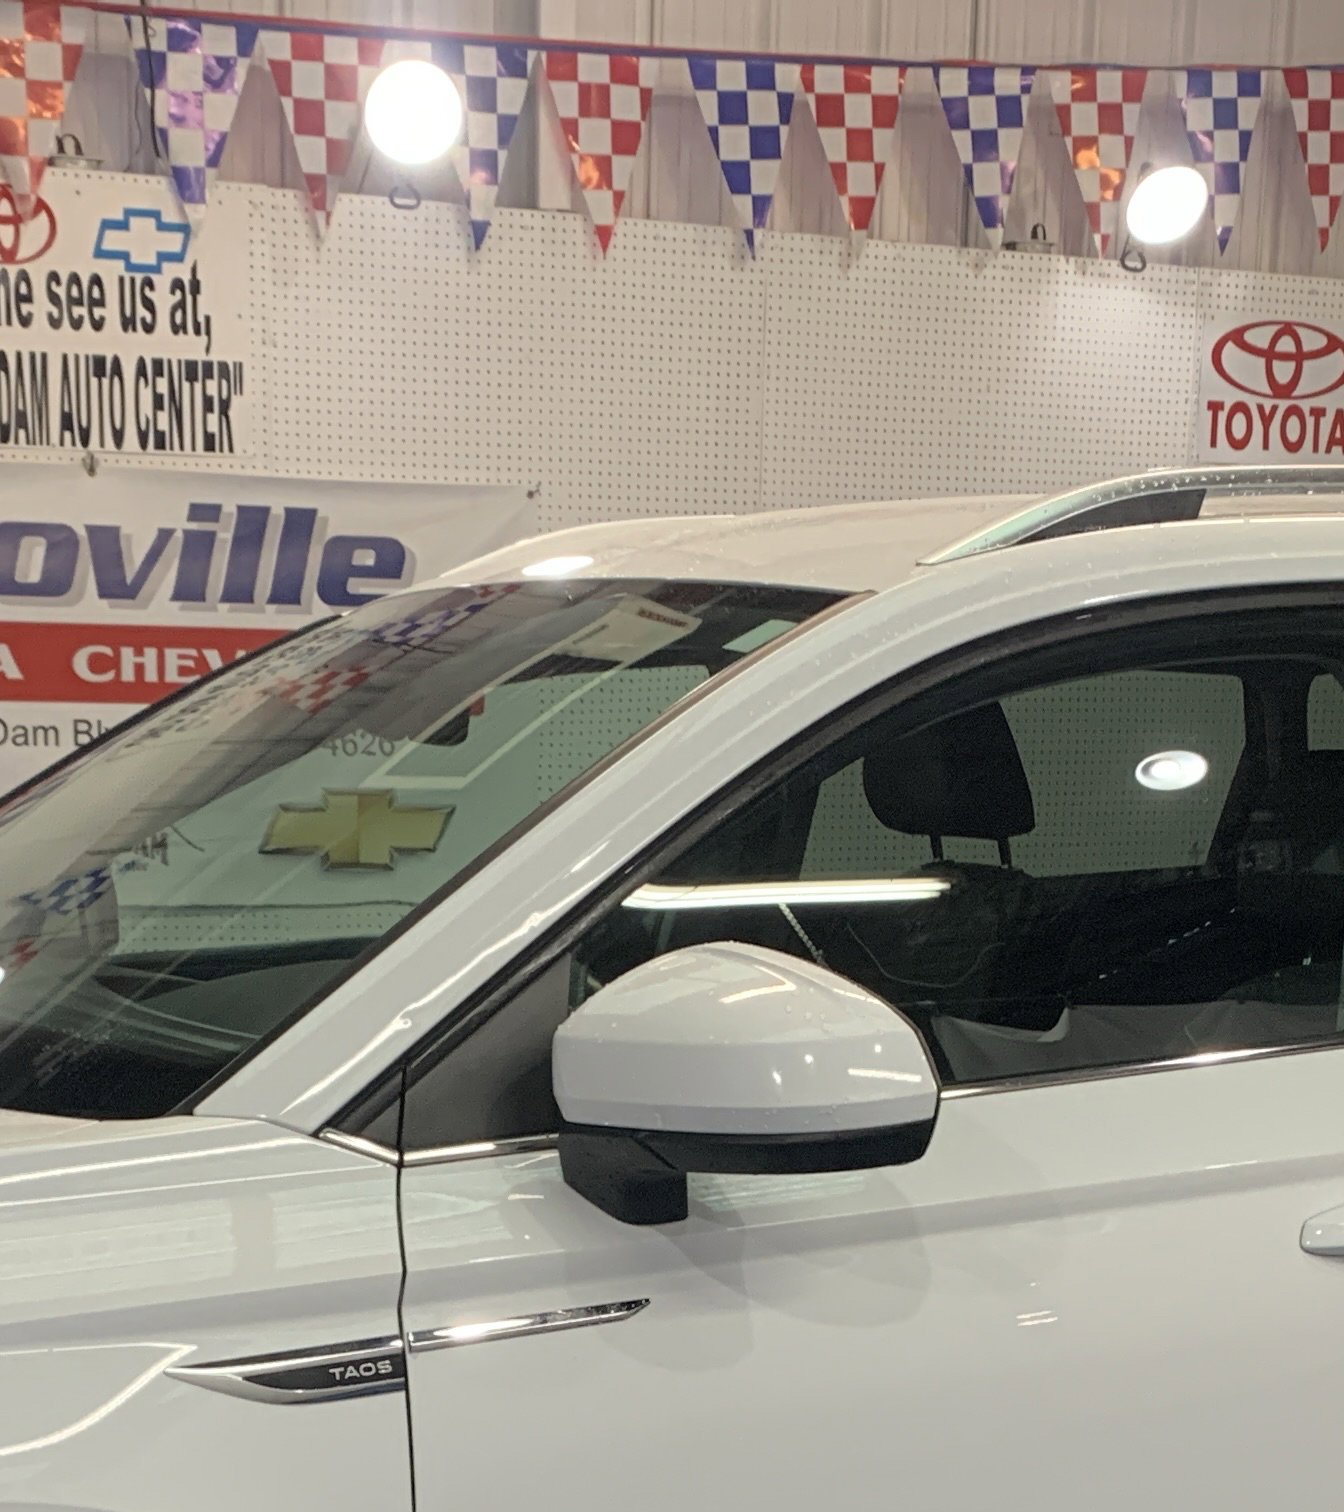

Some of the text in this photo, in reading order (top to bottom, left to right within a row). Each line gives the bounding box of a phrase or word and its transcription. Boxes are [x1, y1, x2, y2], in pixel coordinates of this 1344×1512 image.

[46, 271, 106, 332] see
[118, 274, 156, 335] us
[169, 259, 212, 355] at,
[59, 353, 124, 450] AUTO
[134, 355, 243, 453] CENTER"
[329, 1360, 393, 1380] TAOS
